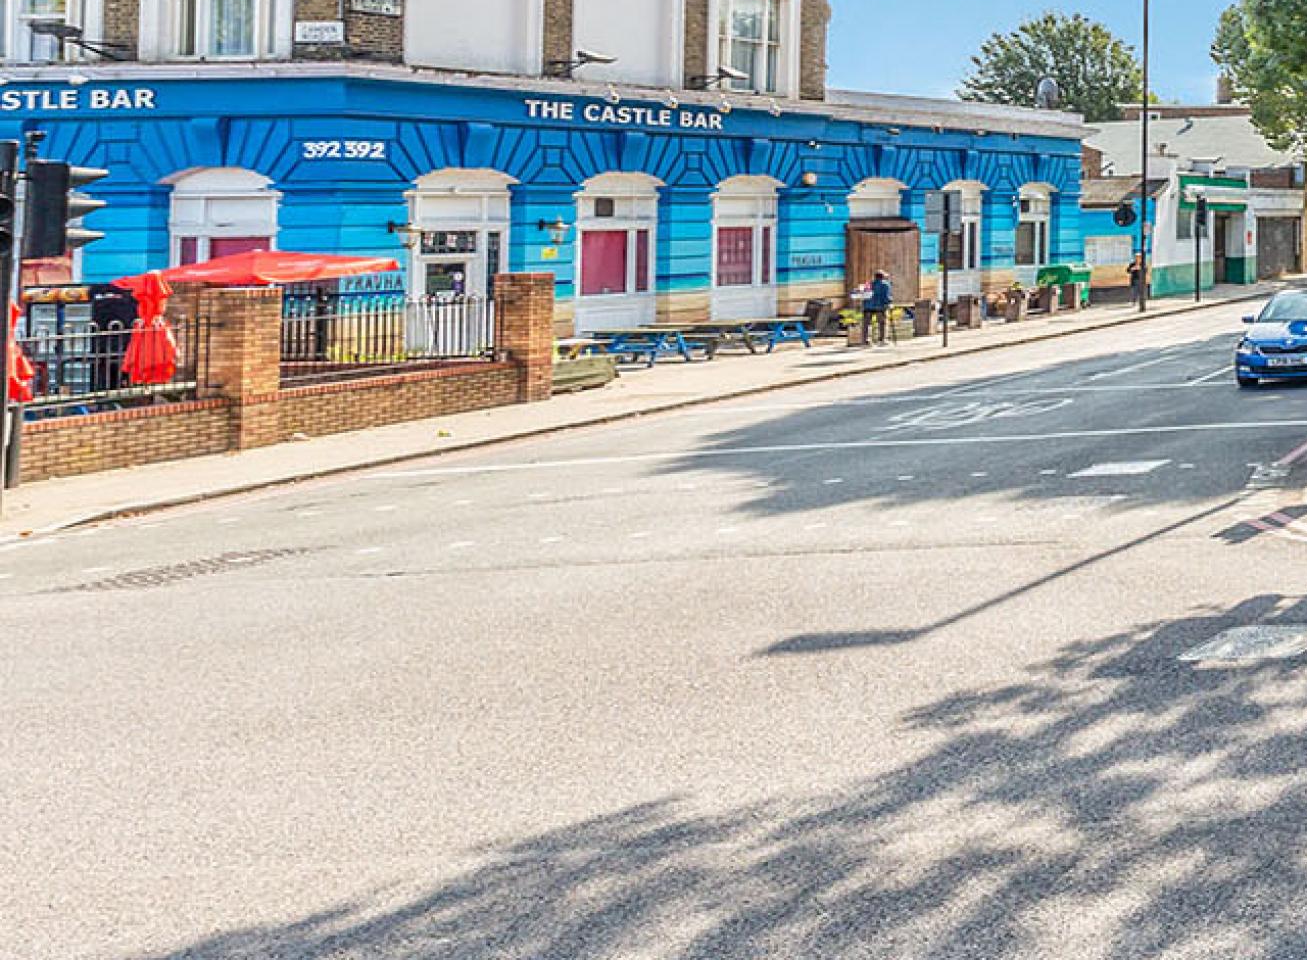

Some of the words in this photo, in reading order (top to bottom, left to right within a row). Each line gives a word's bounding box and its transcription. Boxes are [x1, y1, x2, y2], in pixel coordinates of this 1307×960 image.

[90, 89, 156, 109] BAR
[525, 99, 574, 120] THE
[584, 104, 672, 127] CASTLE
[680, 111, 724, 130] BAR
